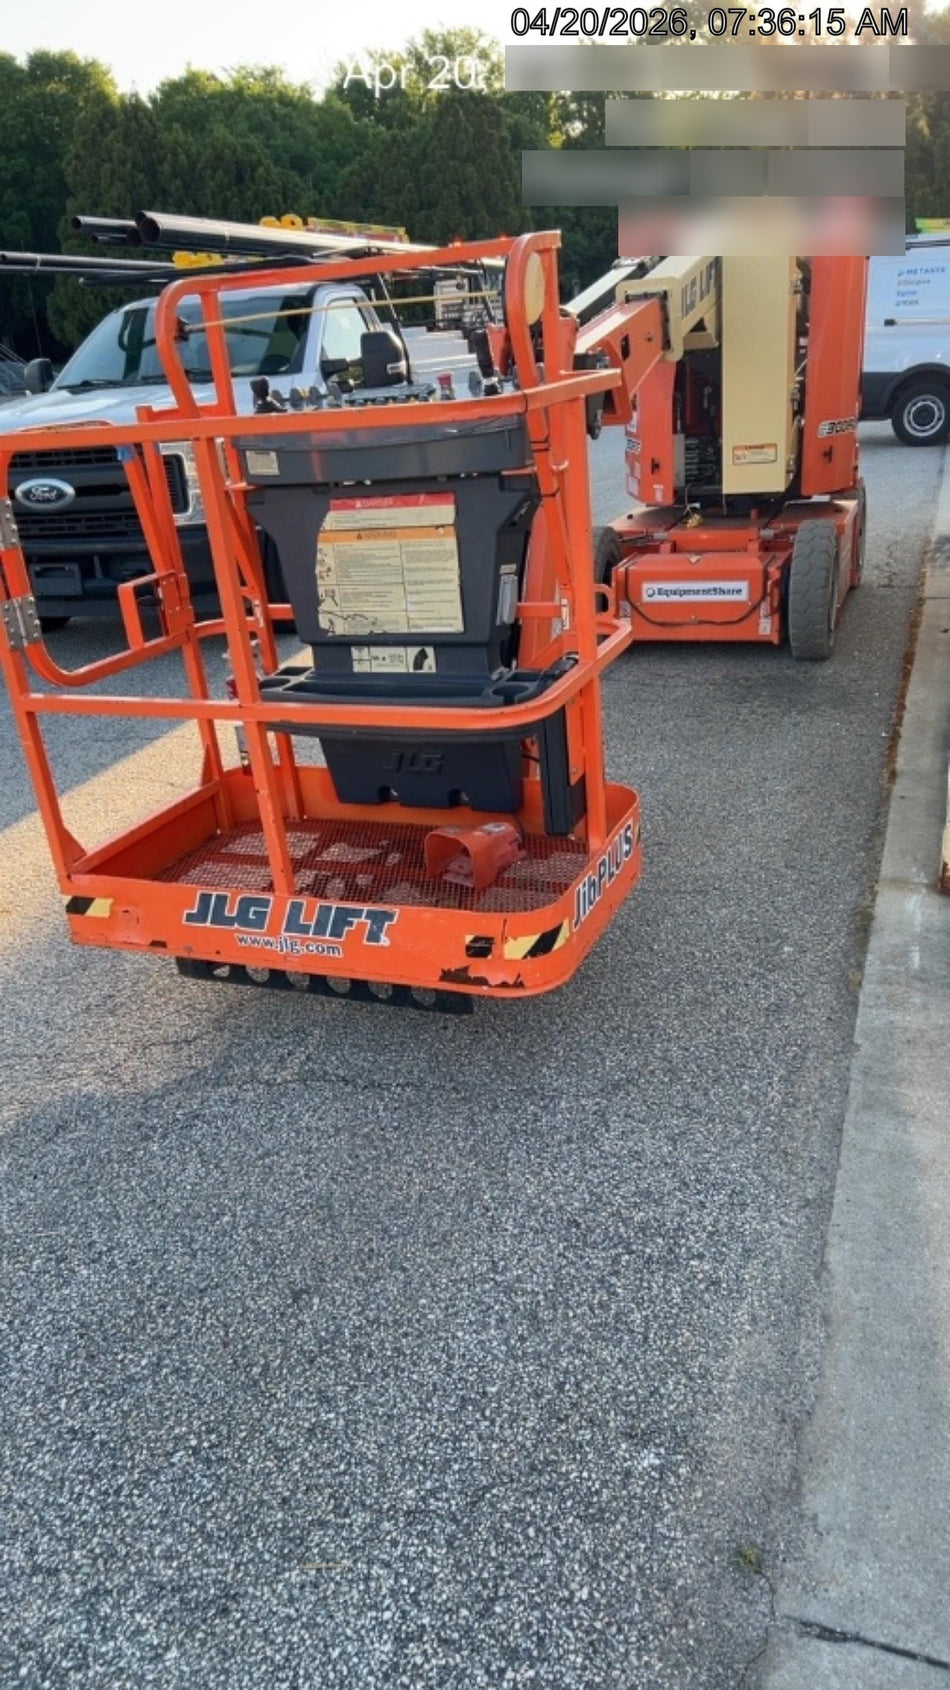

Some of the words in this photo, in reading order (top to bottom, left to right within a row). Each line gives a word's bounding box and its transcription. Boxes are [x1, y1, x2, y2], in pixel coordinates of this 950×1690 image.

[29, 486, 57, 500] Ford
[656, 587, 743, 597] EquipmentShare
[384, 750, 445, 775] JLG
[573, 820, 633, 931] JibPLUS
[183, 891, 273, 931] JLG
[282, 899, 399, 945] LIFT
[236, 934, 343, 957] www.jlg.com
